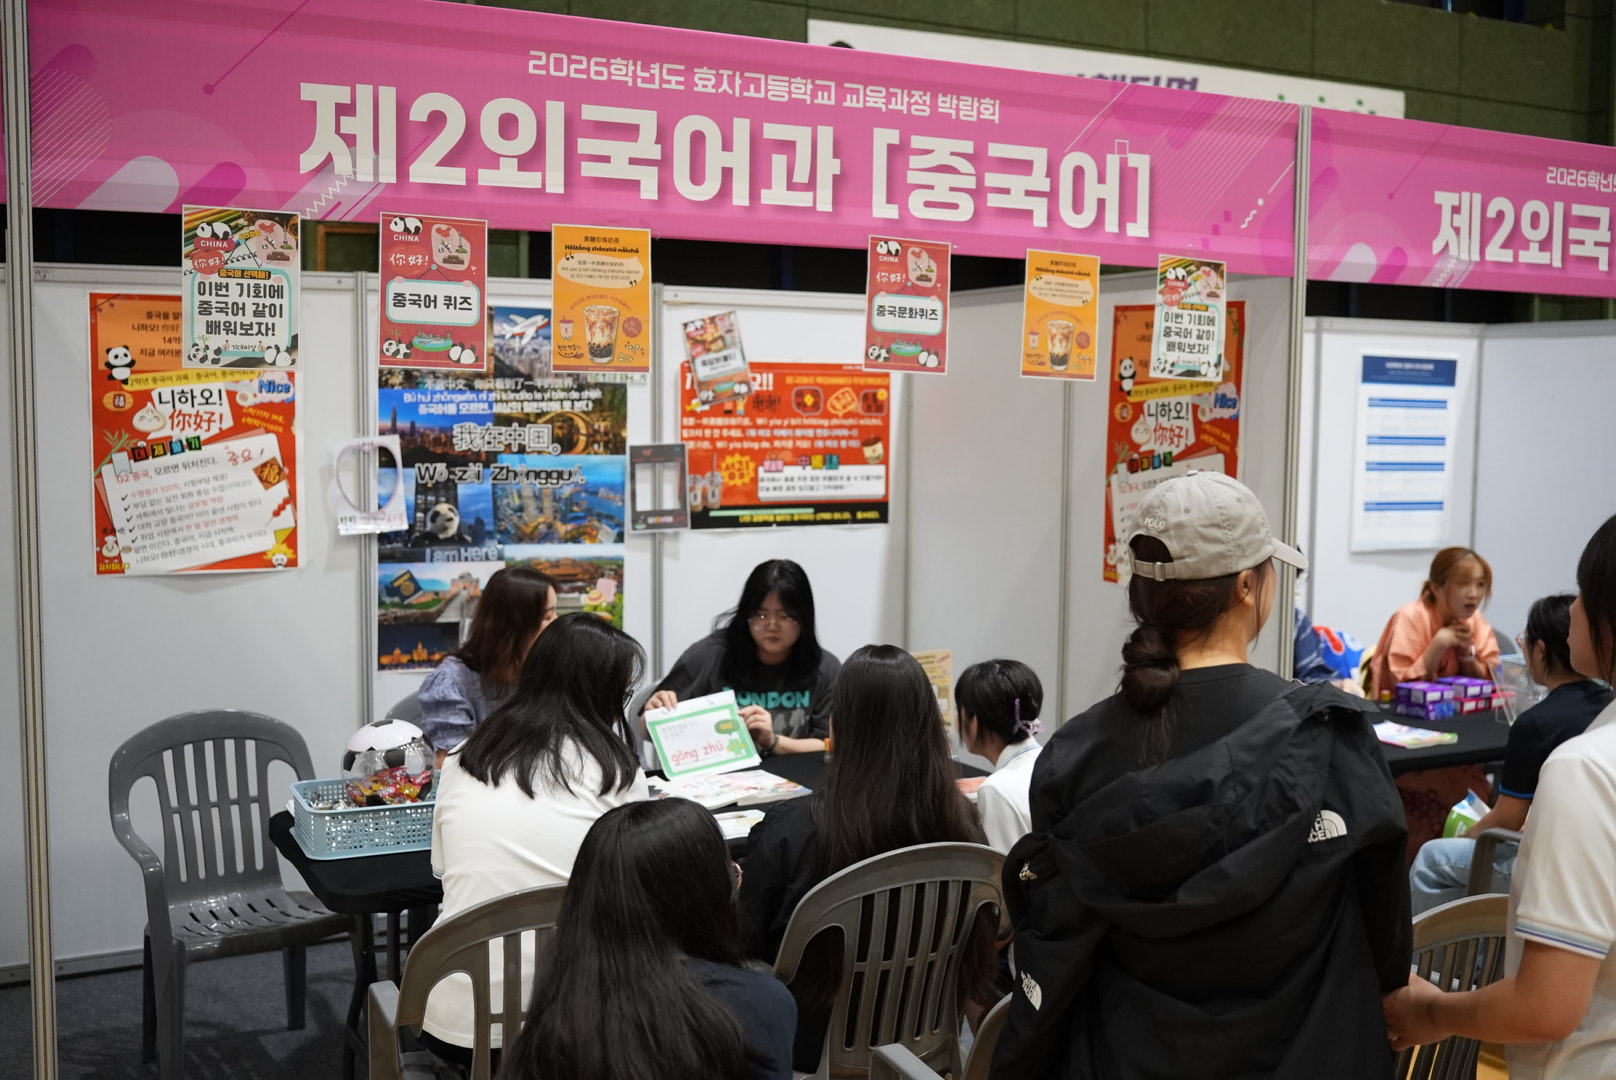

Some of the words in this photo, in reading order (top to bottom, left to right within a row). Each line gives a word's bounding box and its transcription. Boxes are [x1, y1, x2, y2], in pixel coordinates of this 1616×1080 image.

[528, 50, 685, 91] 2026학년도
[693, 66, 836, 106] 효자고등학교
[843, 82, 931, 117] 교육과정
[937, 93, 1001, 124] 박람회
[299, 82, 841, 212] 제2외국어과
[872, 127, 1151, 239] [중국어]
[1546, 166, 1616, 192] 2026학년
[200, 239, 229, 249] CHINA
[393, 234, 420, 243] CHINA
[194, 256, 226, 267] 你好!
[389, 253, 429, 266] 你好!
[879, 255, 899, 263] CHINA
[219, 268, 243, 278] 중국어
[243, 269, 270, 280] 선택해!
[876, 271, 906, 283] 你好!
[197, 281, 230, 298] 이번
[235, 283, 284, 300] 기회에
[392, 292, 438, 309] 중국어
[443, 295, 473, 311] 퀴즈
[197, 300, 247, 318] 중국어
[251, 302, 284, 319] 같이
[876, 304, 939, 321] 중국문화퀴즈
[1164, 312, 1184, 325] 이번
[1187, 313, 1217, 327] 기회에
[132, 323, 160, 332] 니하오!
[205, 320, 277, 337] 배워보자!
[1162, 326, 1193, 339] 중국어
[1195, 329, 1216, 342] 같이
[162, 336, 182, 345] 14억
[140, 348, 155, 357] 지금
[1166, 342, 1210, 355] 배워보자!
[130, 378, 149, 386] 2학년
[152, 376, 173, 384] 중국어
[258, 379, 292, 394] Nice
[158, 388, 224, 410] 니하오!
[1147, 401, 1190, 422] 니하오!
[168, 410, 224, 433] 你好!
[452, 422, 562, 456] 我在中国。
[1153, 423, 1190, 448] 你好!
[154, 463, 180, 476] 모르면
[1143, 517, 1166, 529] POLO
[424, 548, 432, 564] I
[432, 550, 462, 563] am
[462, 547, 499, 562] Here
[722, 686, 811, 709] ONDON
